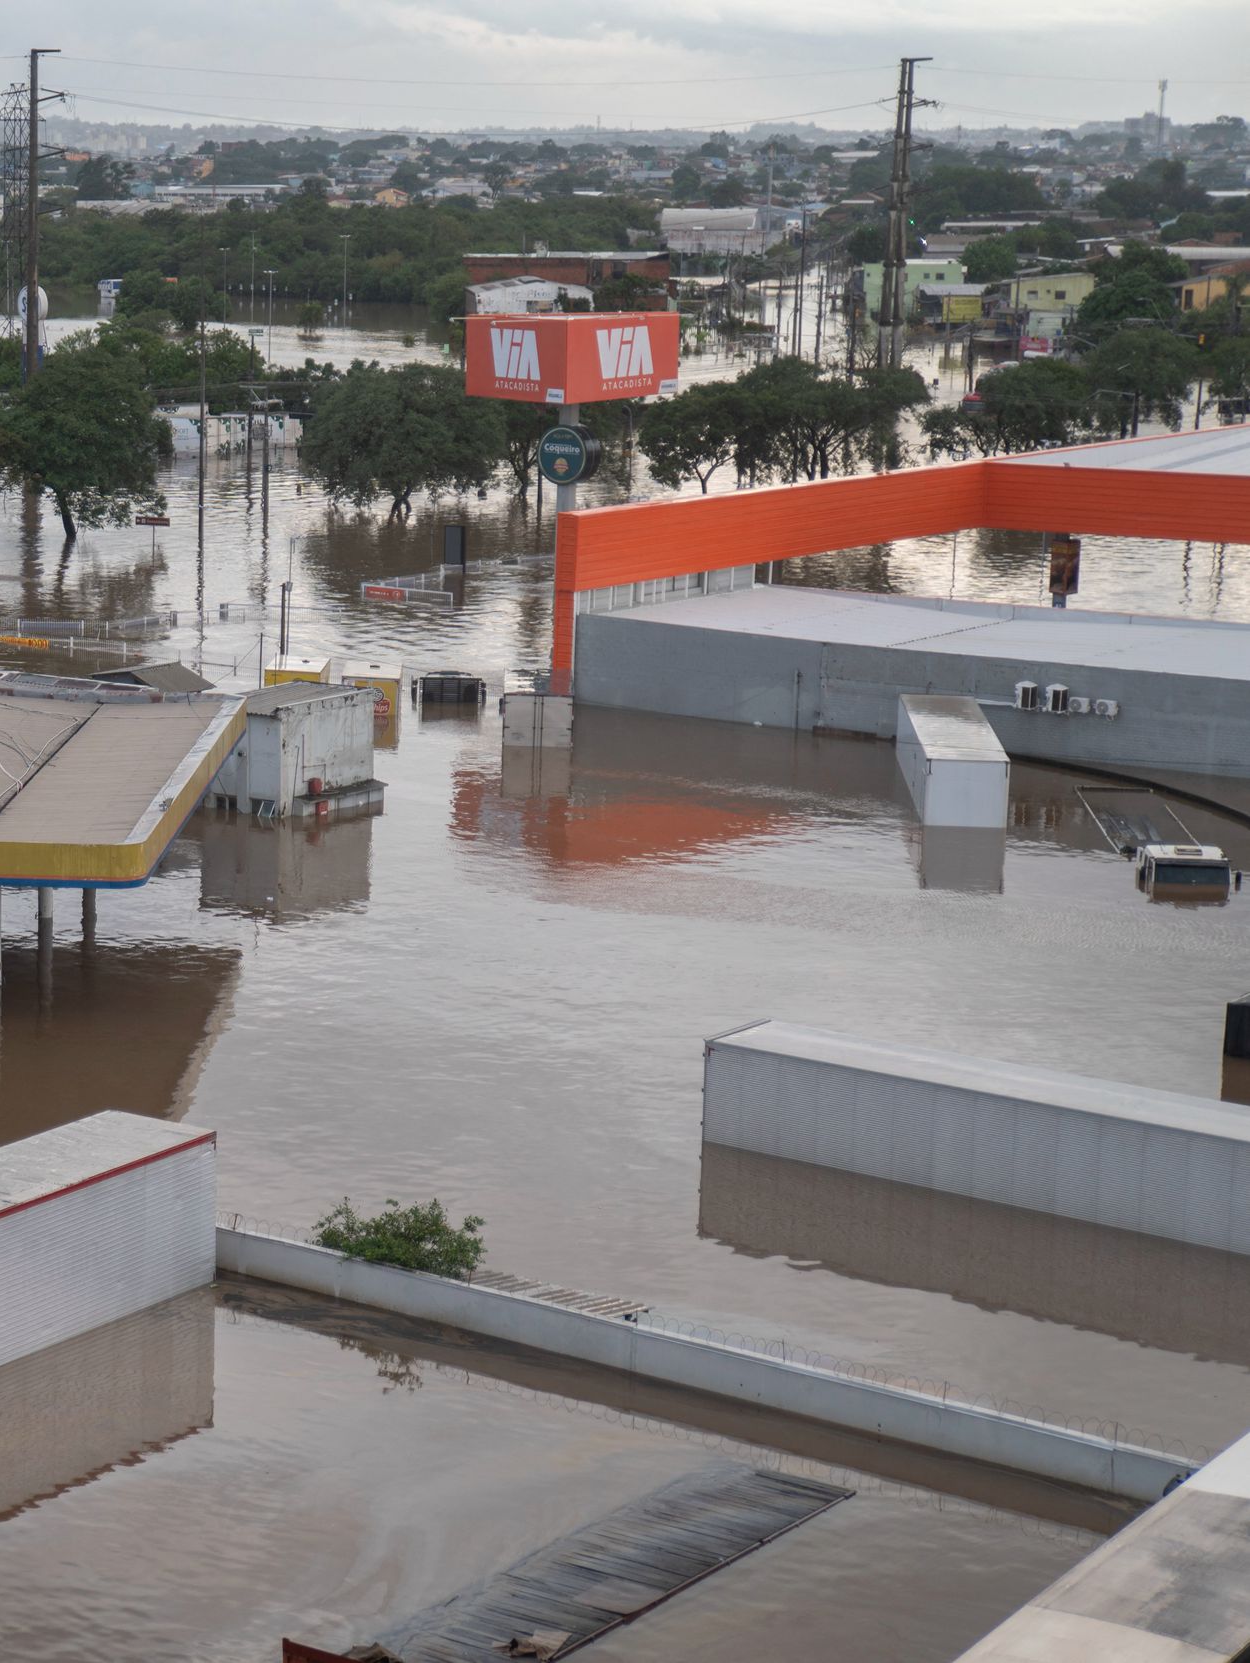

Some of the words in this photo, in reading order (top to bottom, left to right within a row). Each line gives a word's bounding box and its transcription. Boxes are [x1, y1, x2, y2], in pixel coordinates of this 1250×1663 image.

[494, 380, 540, 392] ATACADISTA
[602, 377, 653, 391] ATACADISTA
[544, 443, 581, 455] Coqueiro
